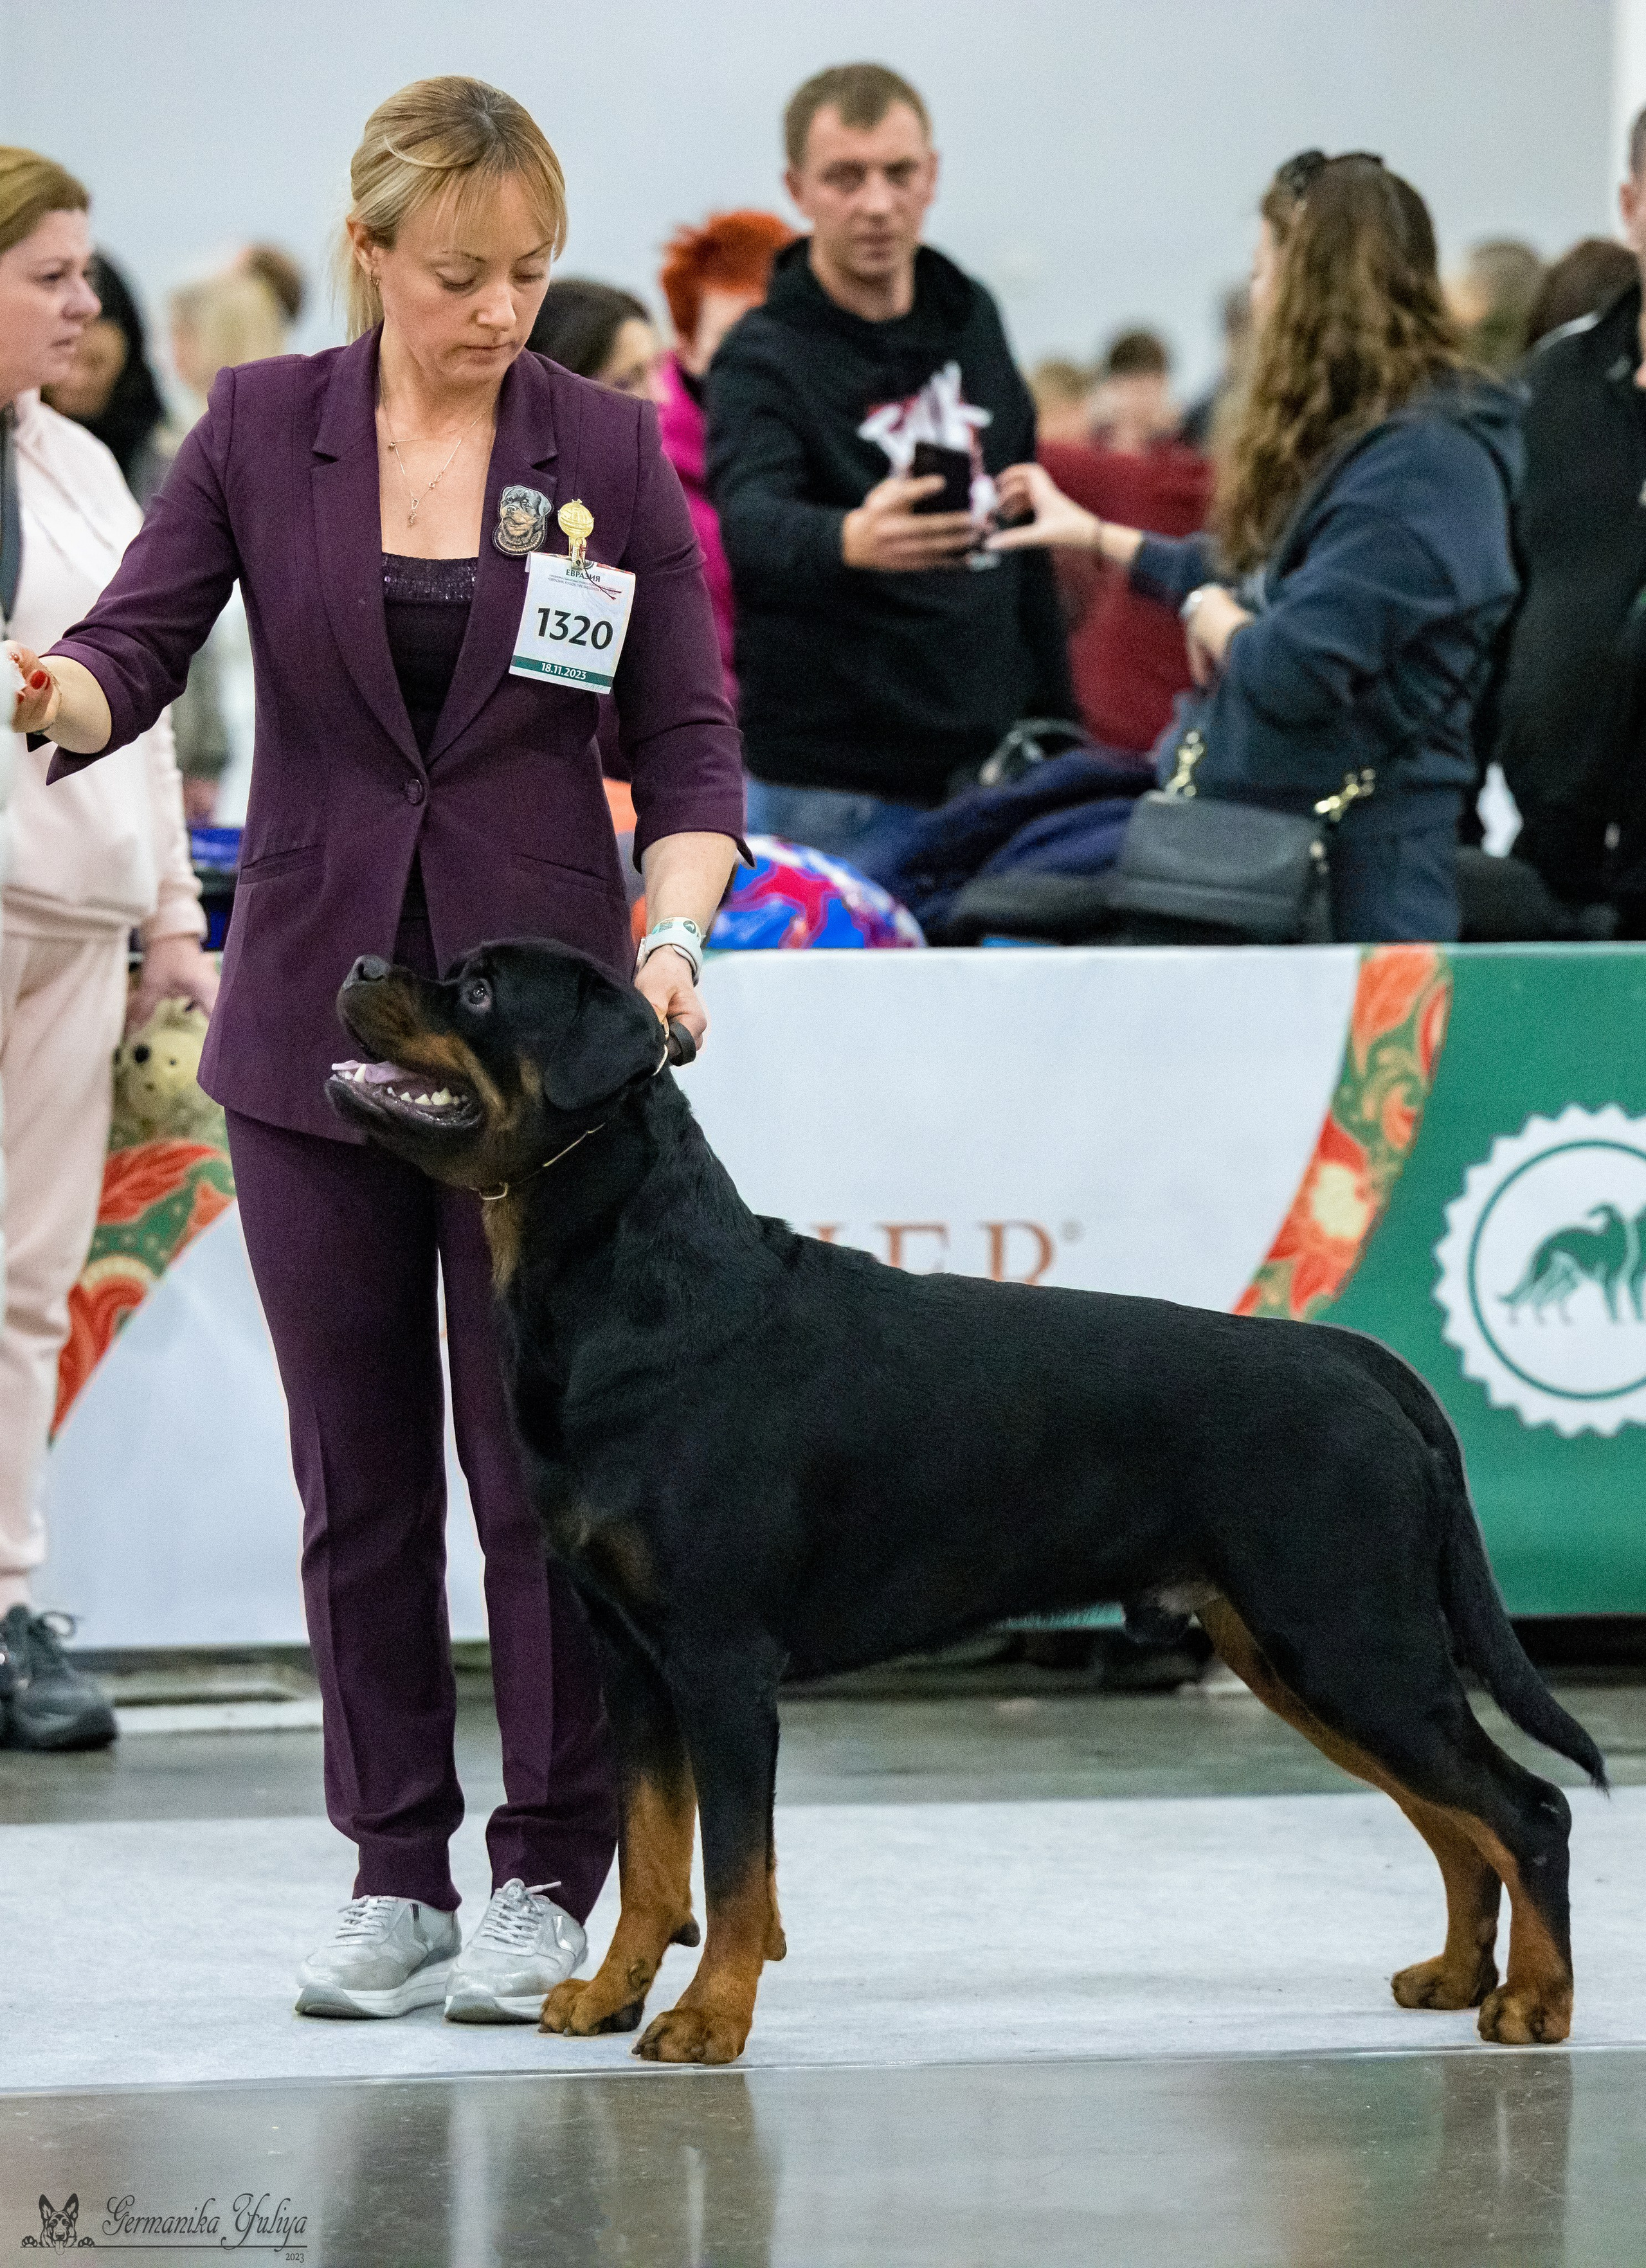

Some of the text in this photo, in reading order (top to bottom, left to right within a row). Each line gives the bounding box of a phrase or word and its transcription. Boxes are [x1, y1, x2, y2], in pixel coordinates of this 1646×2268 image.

[566, 569, 601, 582] ЕВРАЗИЯ
[537, 608, 613, 650] 1320
[541, 663, 587, 680] 18.11.2023
